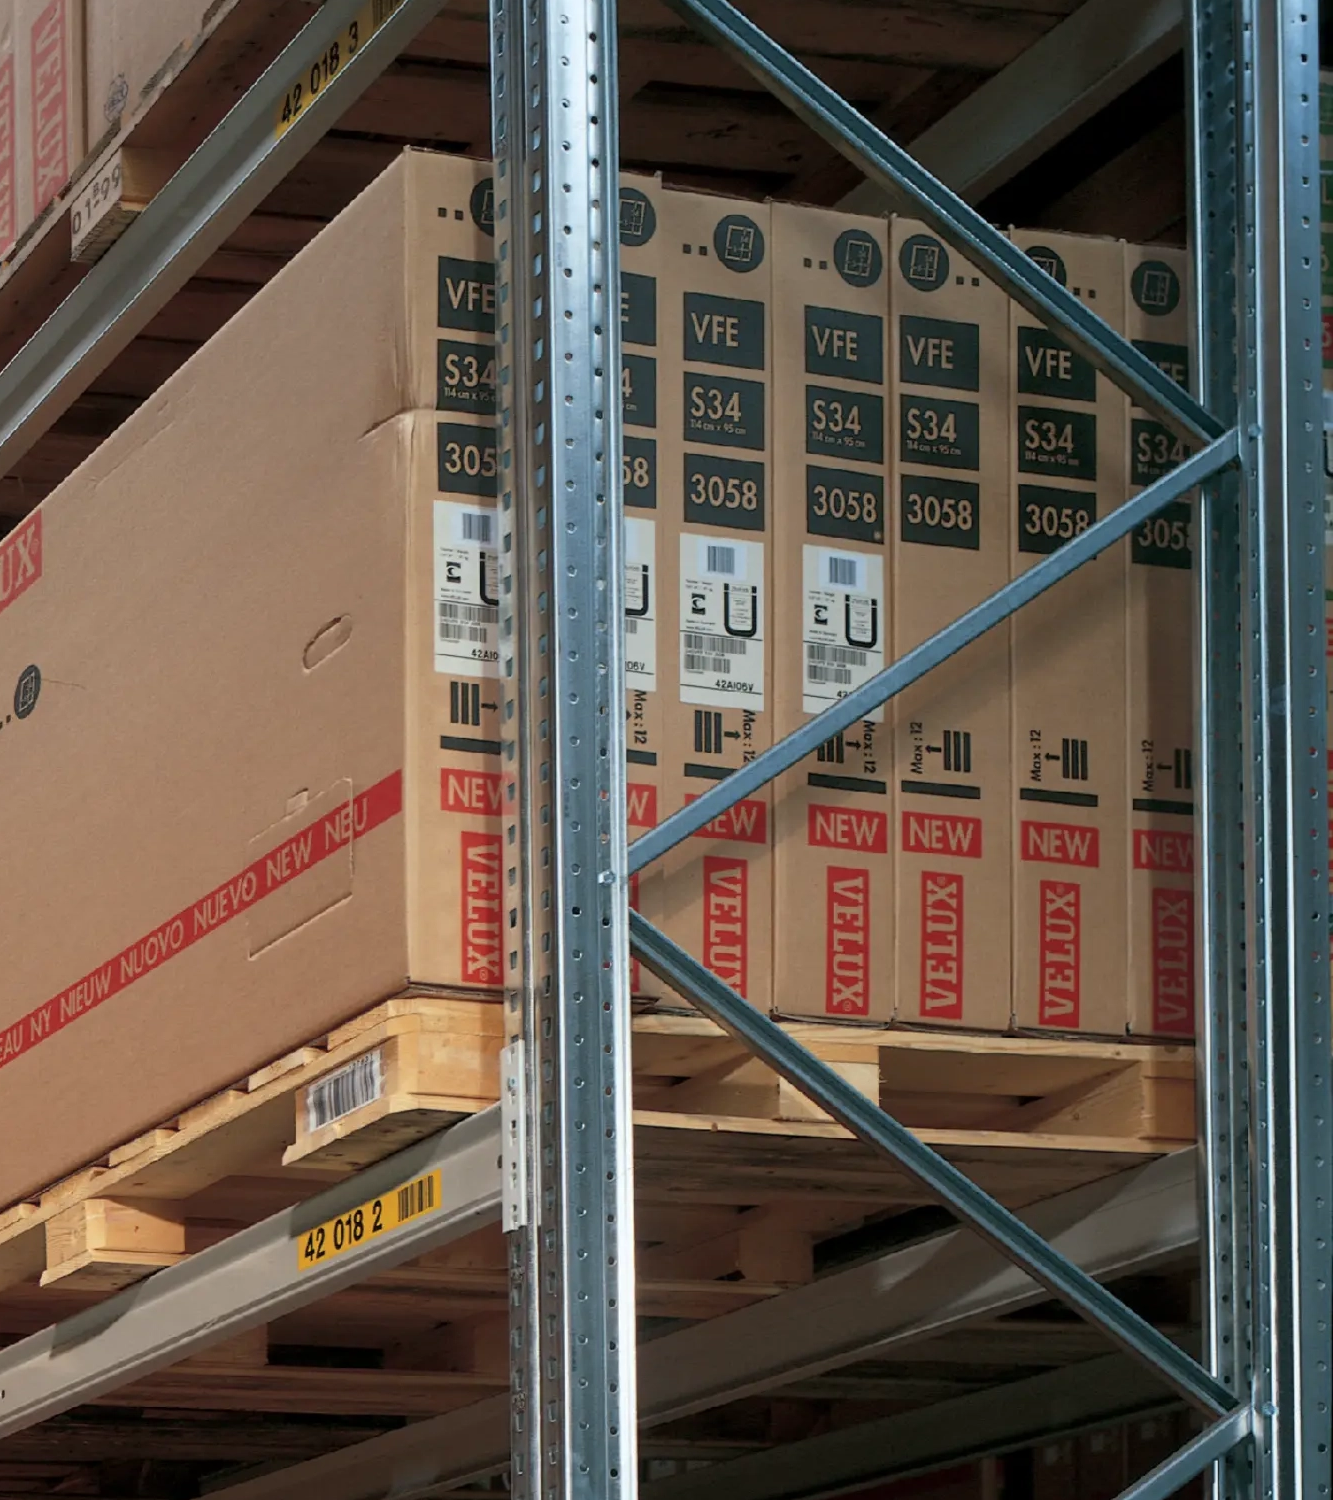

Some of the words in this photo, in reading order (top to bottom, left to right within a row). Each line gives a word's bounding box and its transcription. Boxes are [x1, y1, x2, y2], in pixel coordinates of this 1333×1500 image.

[281, 80, 303, 122] 42
[309, 42, 341, 95] 018
[348, 21, 359, 53] 3
[691, 311, 740, 348] VFE
[812, 326, 858, 362] VFE
[906, 335, 954, 370] VFE
[1025, 345, 1072, 380] VFE
[690, 385, 742, 423] S34
[812, 400, 862, 434] S34
[907, 407, 957, 442] S34
[1025, 419, 1074, 454] S34
[690, 473, 758, 511] 3058
[813, 485, 877, 523] 3058
[907, 494, 973, 531] 3058
[1025, 503, 1089, 538] 3058
[816, 812, 878, 846] NEW
[908, 818, 974, 853] NEW
[1028, 827, 1093, 864] NEW
[31, 1012, 52, 1041] NY
[60, 973, 112, 1026] NIEUW
[121, 920, 184, 978] NUOVO
[193, 876, 257, 936] NUEVO
[266, 839, 313, 887] NEW
[325, 801, 368, 848] NEU
[467, 843, 500, 976] VELUX
[833, 876, 864, 1008] VELUX
[925, 880, 958, 1012] VELUX
[1044, 888, 1076, 1018] VELUX
[303, 1228, 327, 1261] 42
[332, 1209, 364, 1249] 018
[371, 1200, 383, 1231] 2
